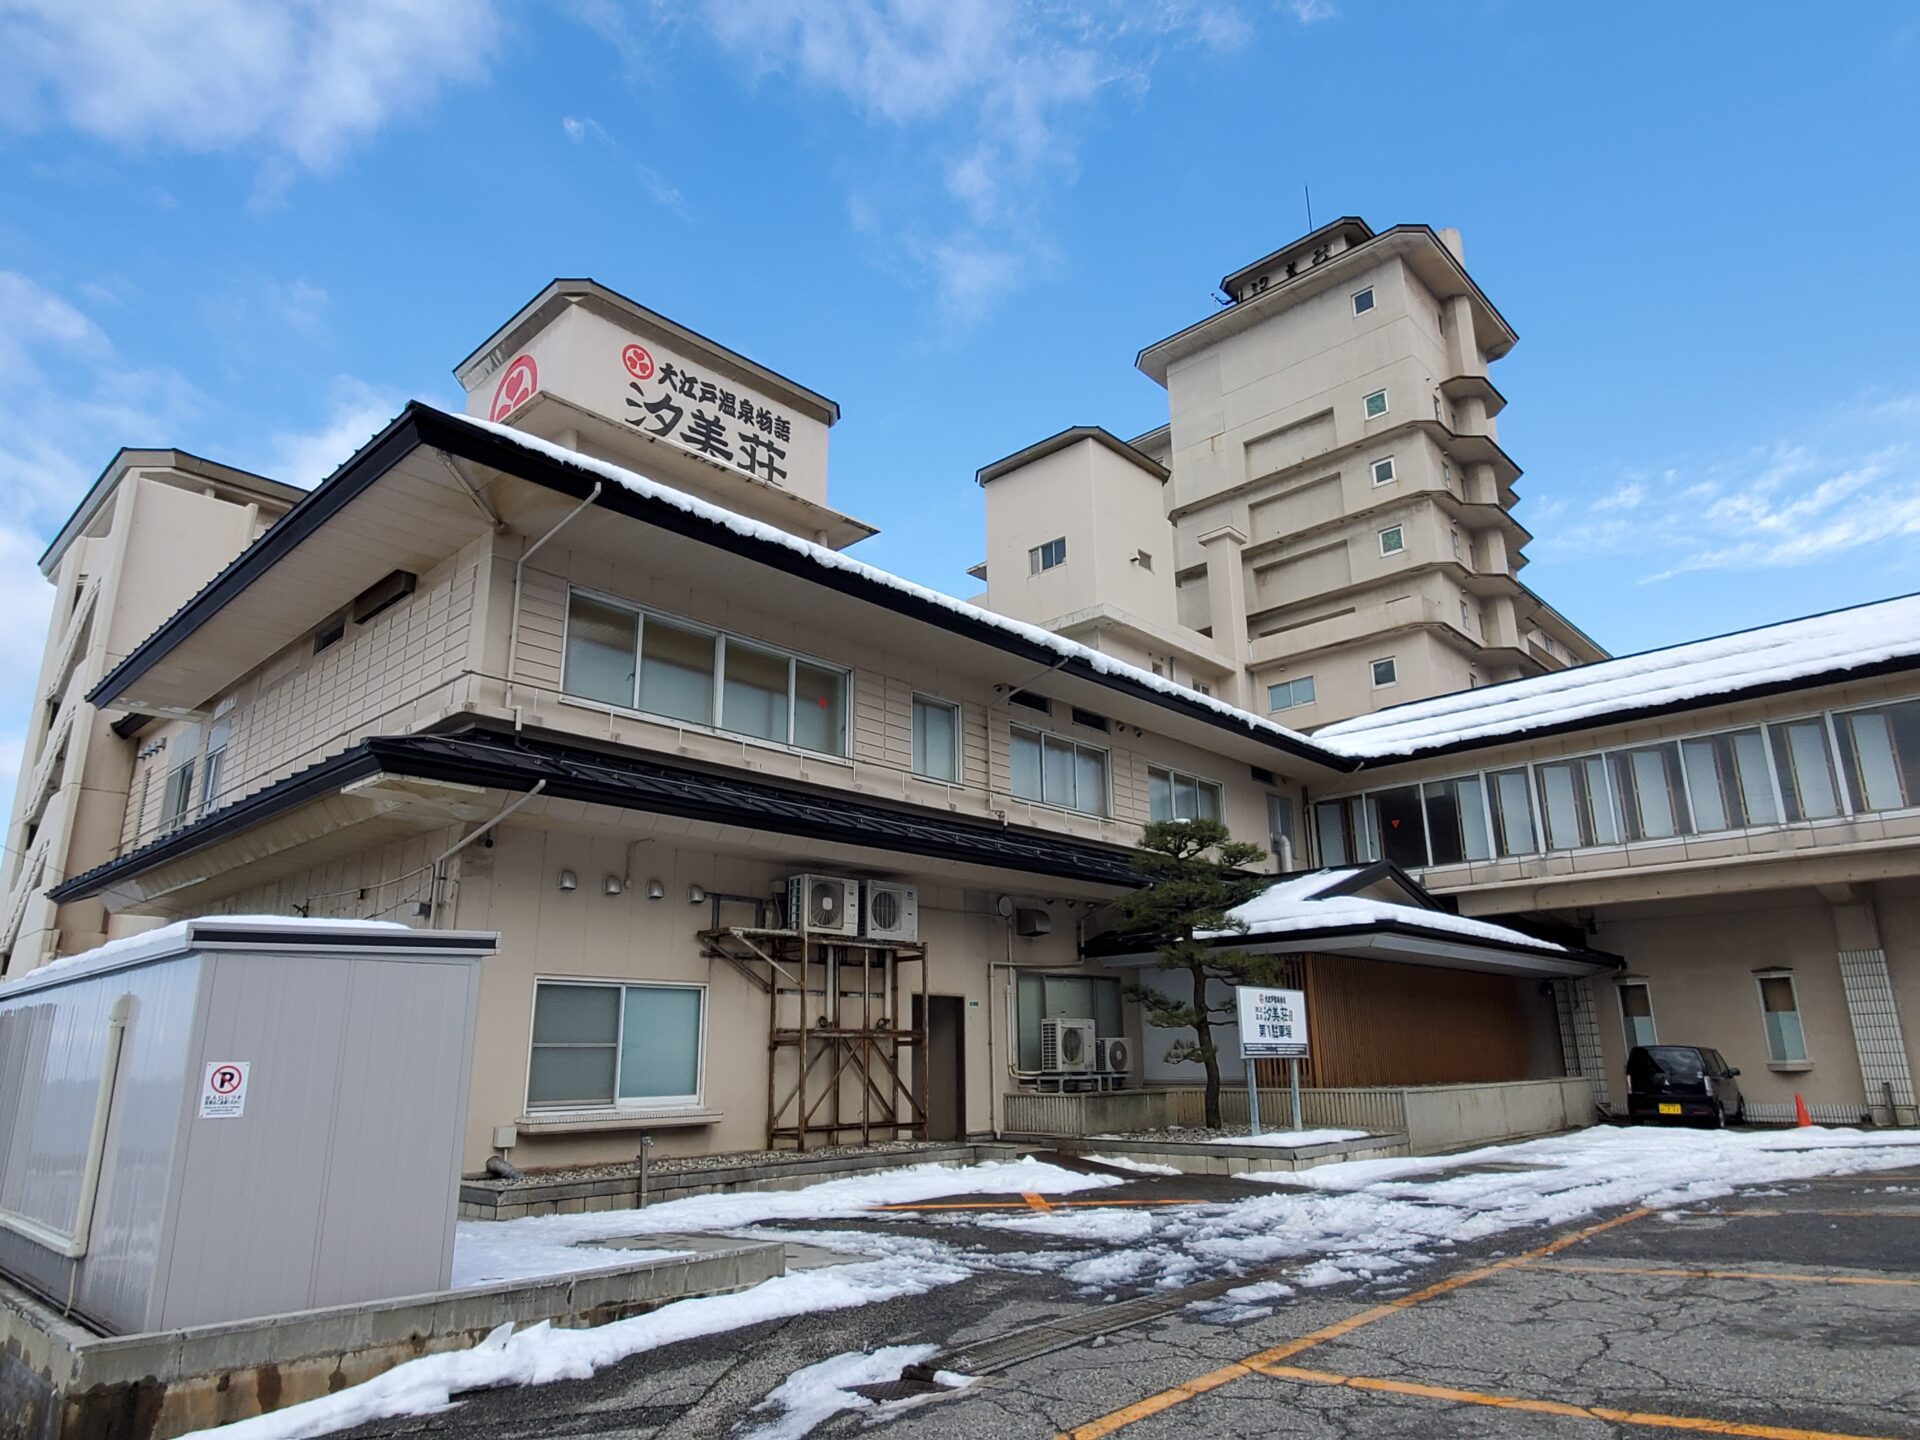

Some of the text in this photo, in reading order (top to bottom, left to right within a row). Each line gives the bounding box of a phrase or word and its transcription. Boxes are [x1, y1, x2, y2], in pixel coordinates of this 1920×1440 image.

[658, 363, 791, 443] 大江戸温泉物語
[625, 382, 788, 487] 汐美荘
[1264, 1006, 1288, 1022] 汐美荘
[1259, 1024, 1292, 1038] 第1駐車場
[219, 1072, 235, 1088] P
